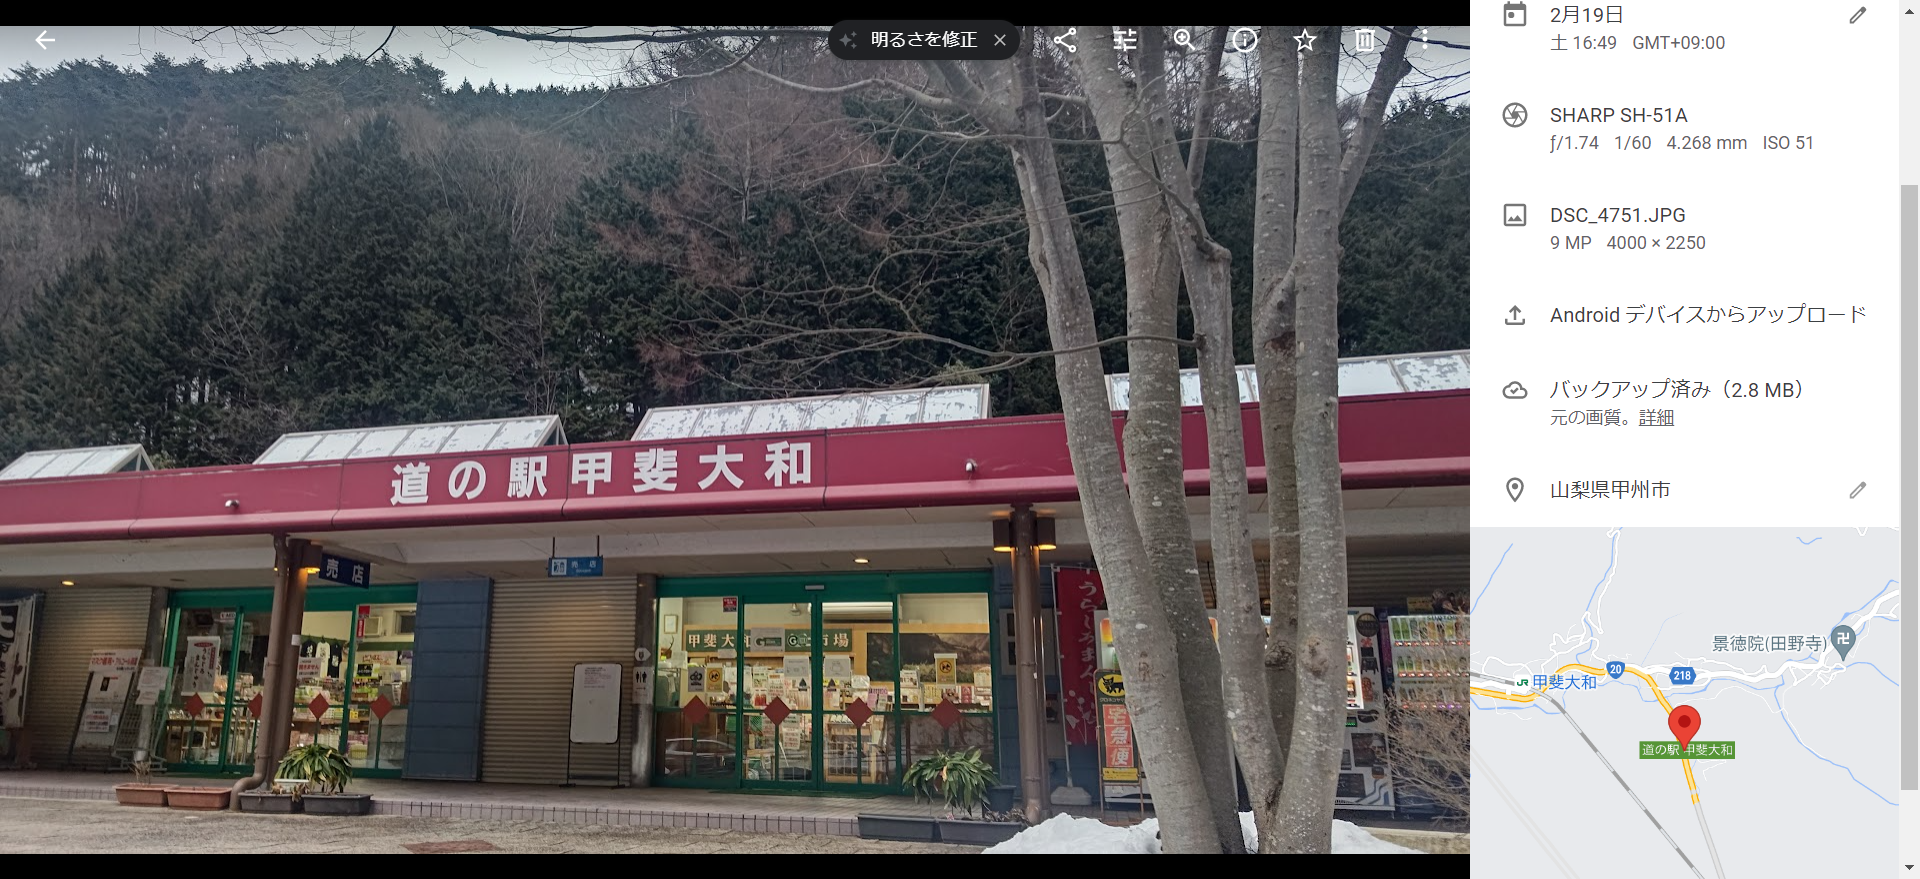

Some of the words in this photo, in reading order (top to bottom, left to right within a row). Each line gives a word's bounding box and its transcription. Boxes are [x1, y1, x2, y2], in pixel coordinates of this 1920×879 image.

[326, 557, 364, 585] 売店
[1107, 705, 1131, 767] 宅急便
